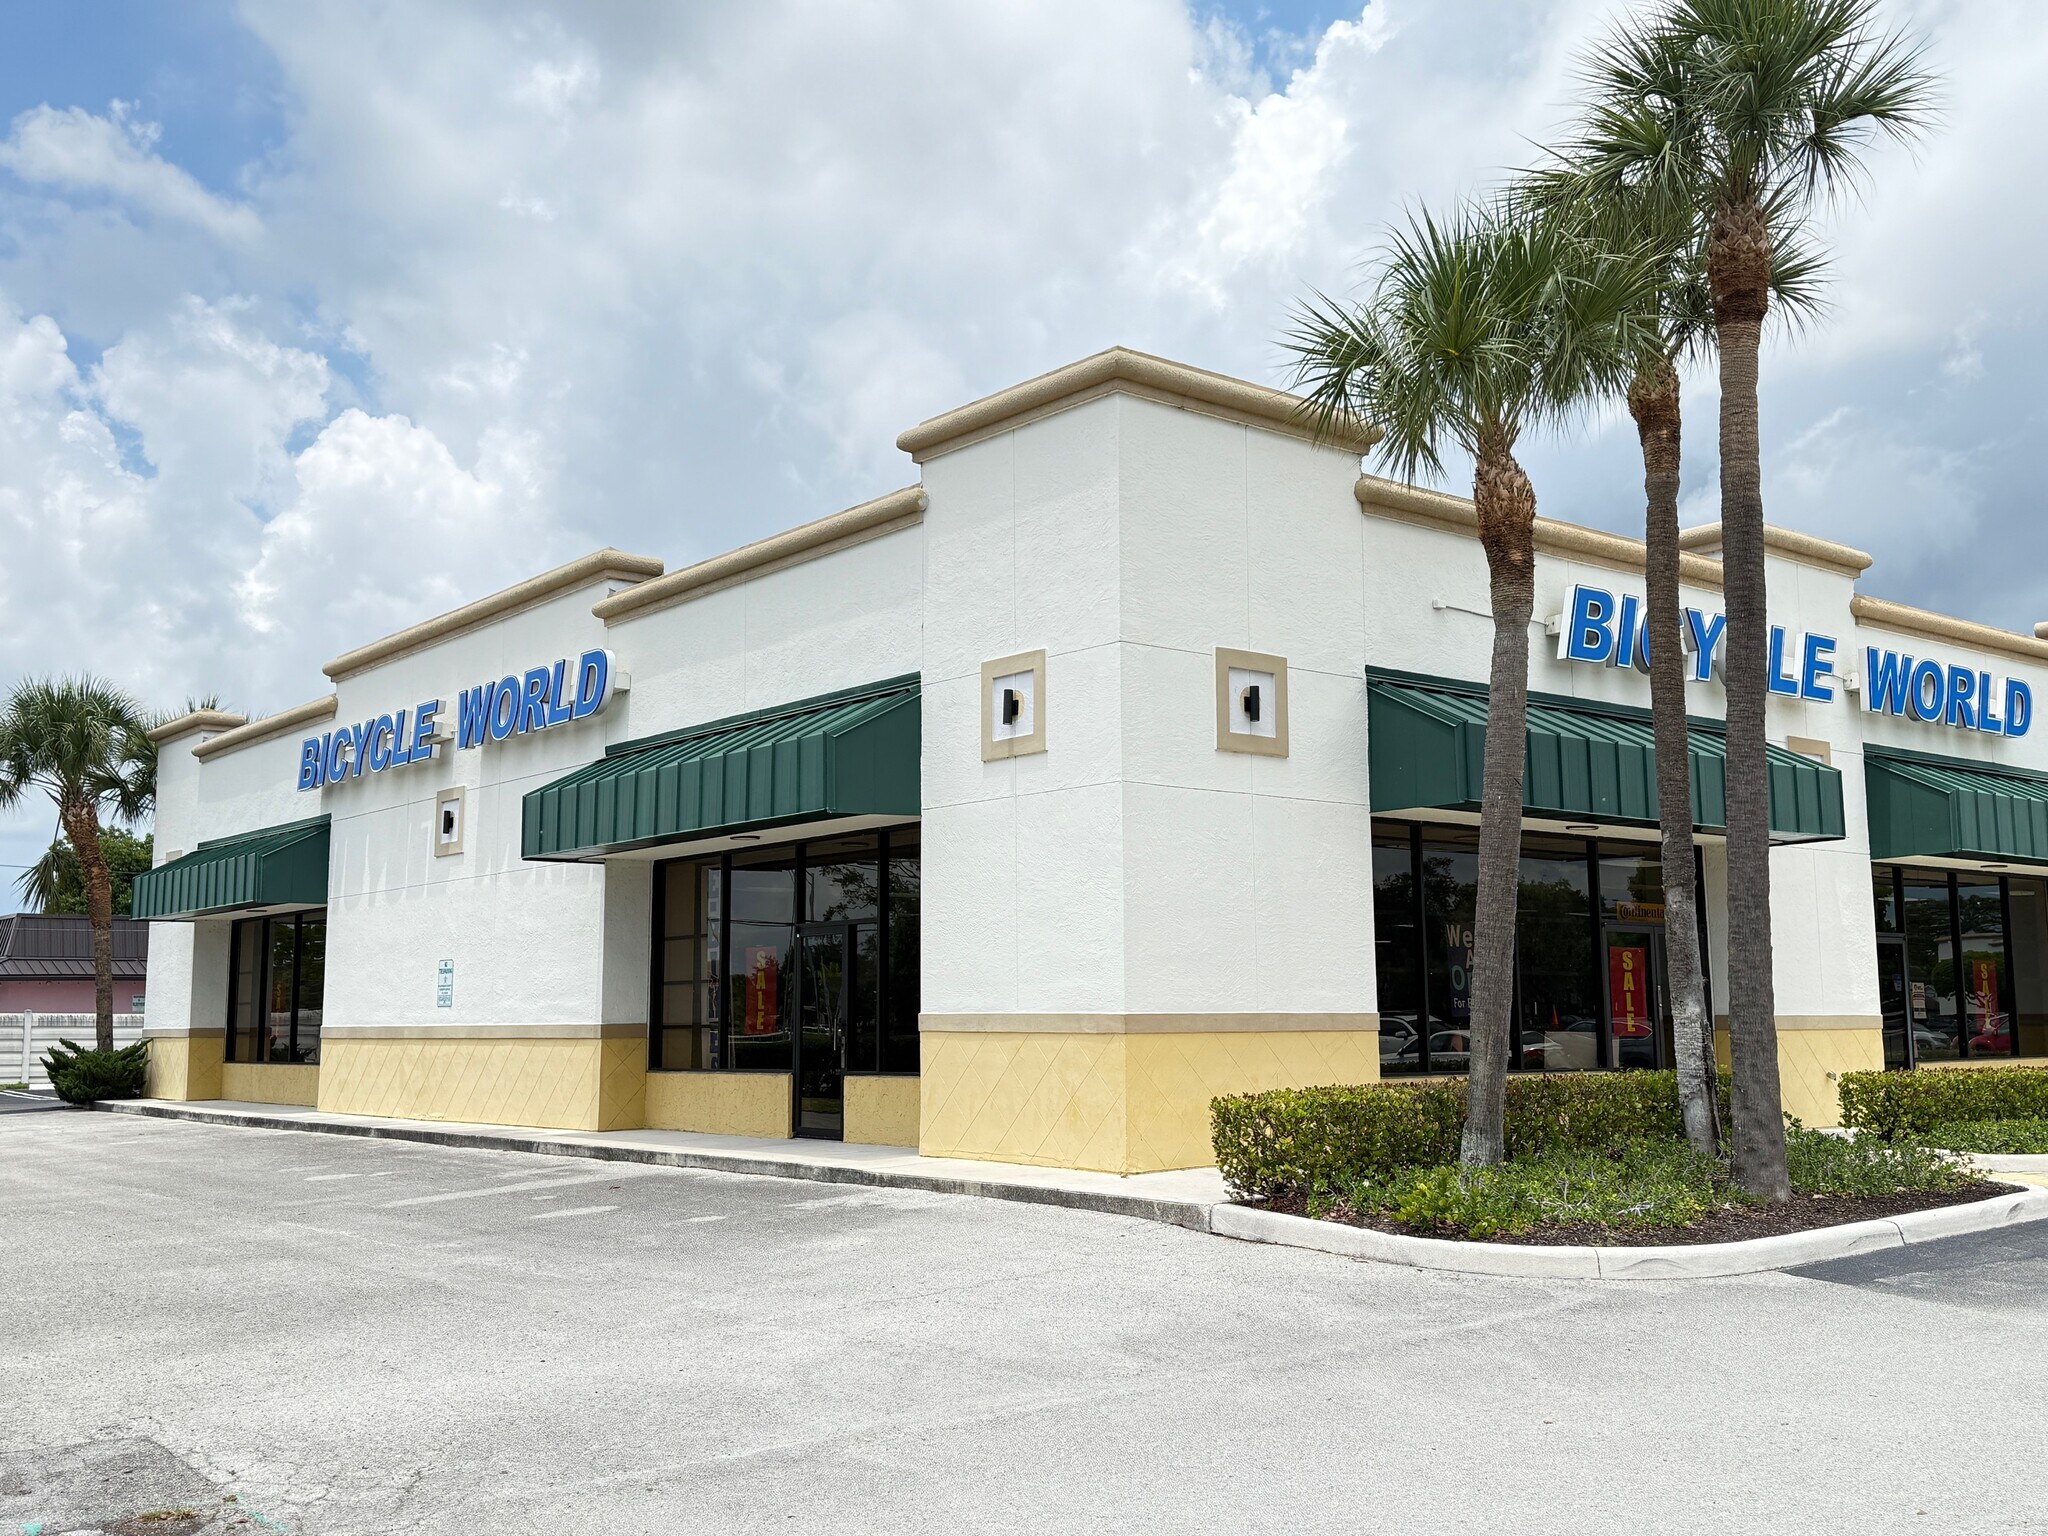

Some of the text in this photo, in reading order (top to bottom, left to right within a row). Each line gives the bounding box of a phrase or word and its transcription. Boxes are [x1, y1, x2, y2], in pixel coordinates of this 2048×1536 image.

[1568, 583, 2034, 738] BIYLE WORLD
[297, 648, 609, 792] BICYCLE WORLD
[1620, 903, 1665, 919] Continenta
[756, 950, 766, 1030] SALE
[1622, 951, 1636, 1032] SALE
